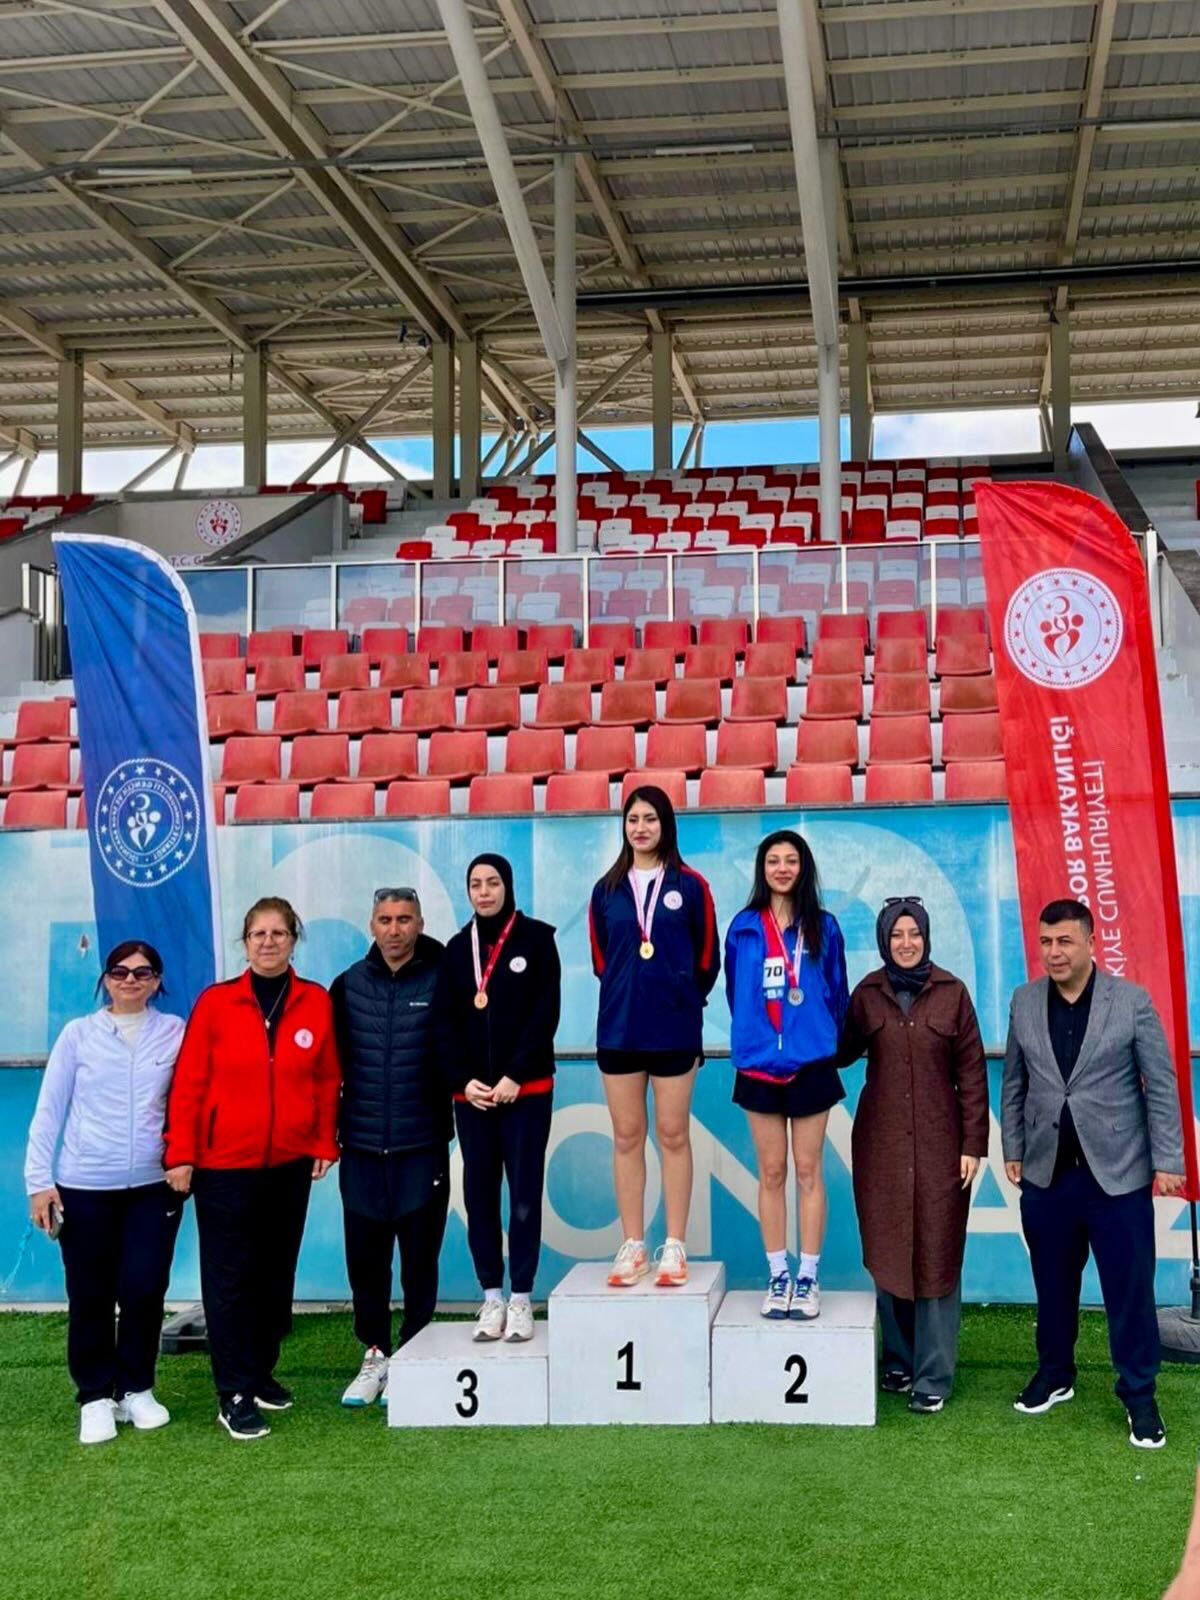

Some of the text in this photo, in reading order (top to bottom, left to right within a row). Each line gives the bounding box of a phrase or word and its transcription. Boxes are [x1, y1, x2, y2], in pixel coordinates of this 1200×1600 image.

[764, 965, 783, 978] 70
[616, 1341, 641, 1391] 1
[784, 1354, 808, 1404] 2
[455, 1369, 478, 1418] 3
